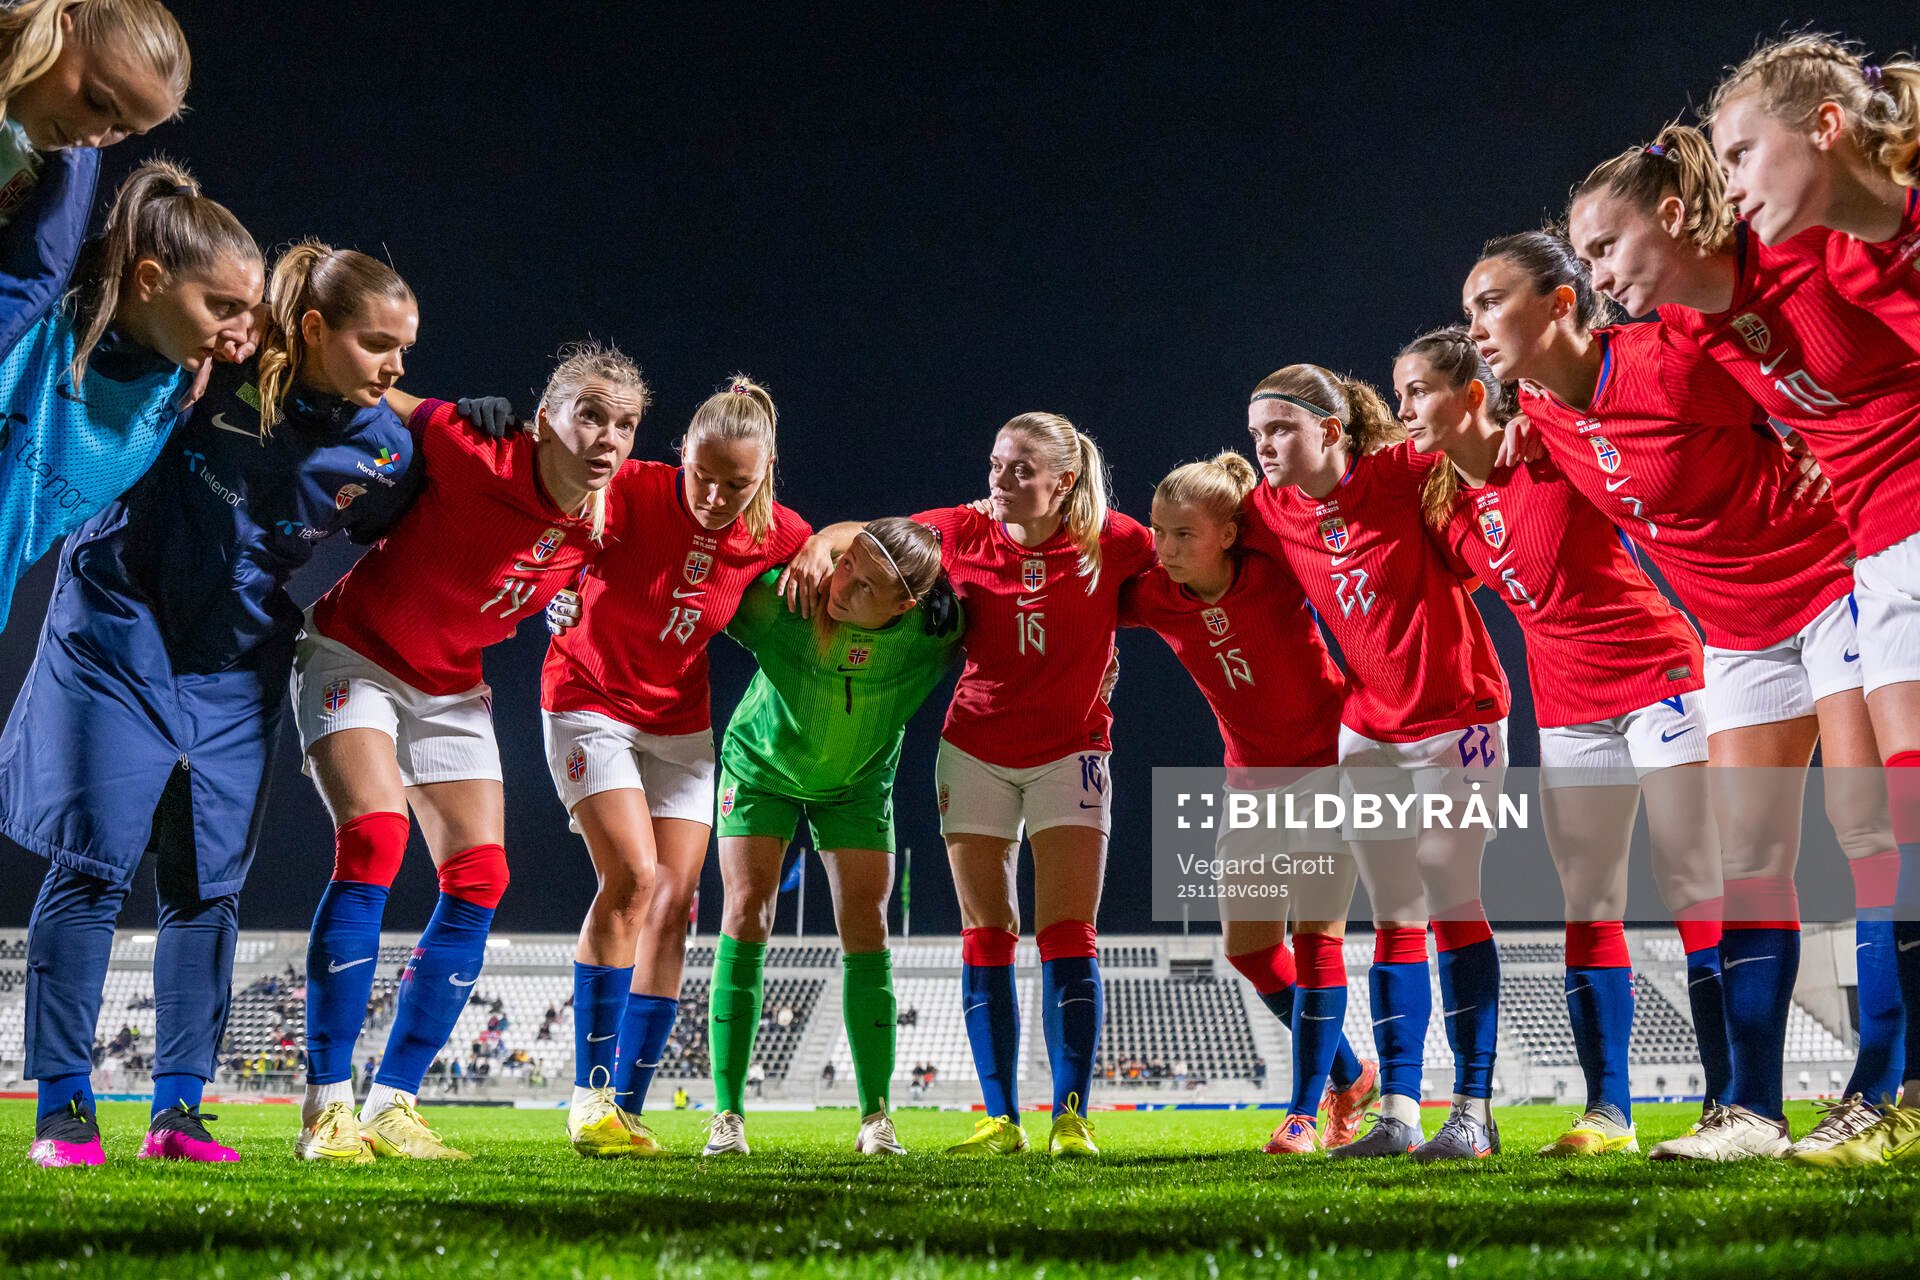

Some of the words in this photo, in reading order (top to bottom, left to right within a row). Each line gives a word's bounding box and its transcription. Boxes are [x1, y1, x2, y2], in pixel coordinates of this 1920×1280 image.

[1775, 369, 1850, 416] 10
[200, 465, 245, 507] telenor
[357, 461, 377, 478] Norsk
[1330, 568, 1376, 619] 22
[659, 606, 702, 645] 18
[1014, 612, 1046, 656] 16
[1214, 648, 1255, 690] 15
[845, 676, 852, 715] 1
[1458, 724, 1495, 768] 22
